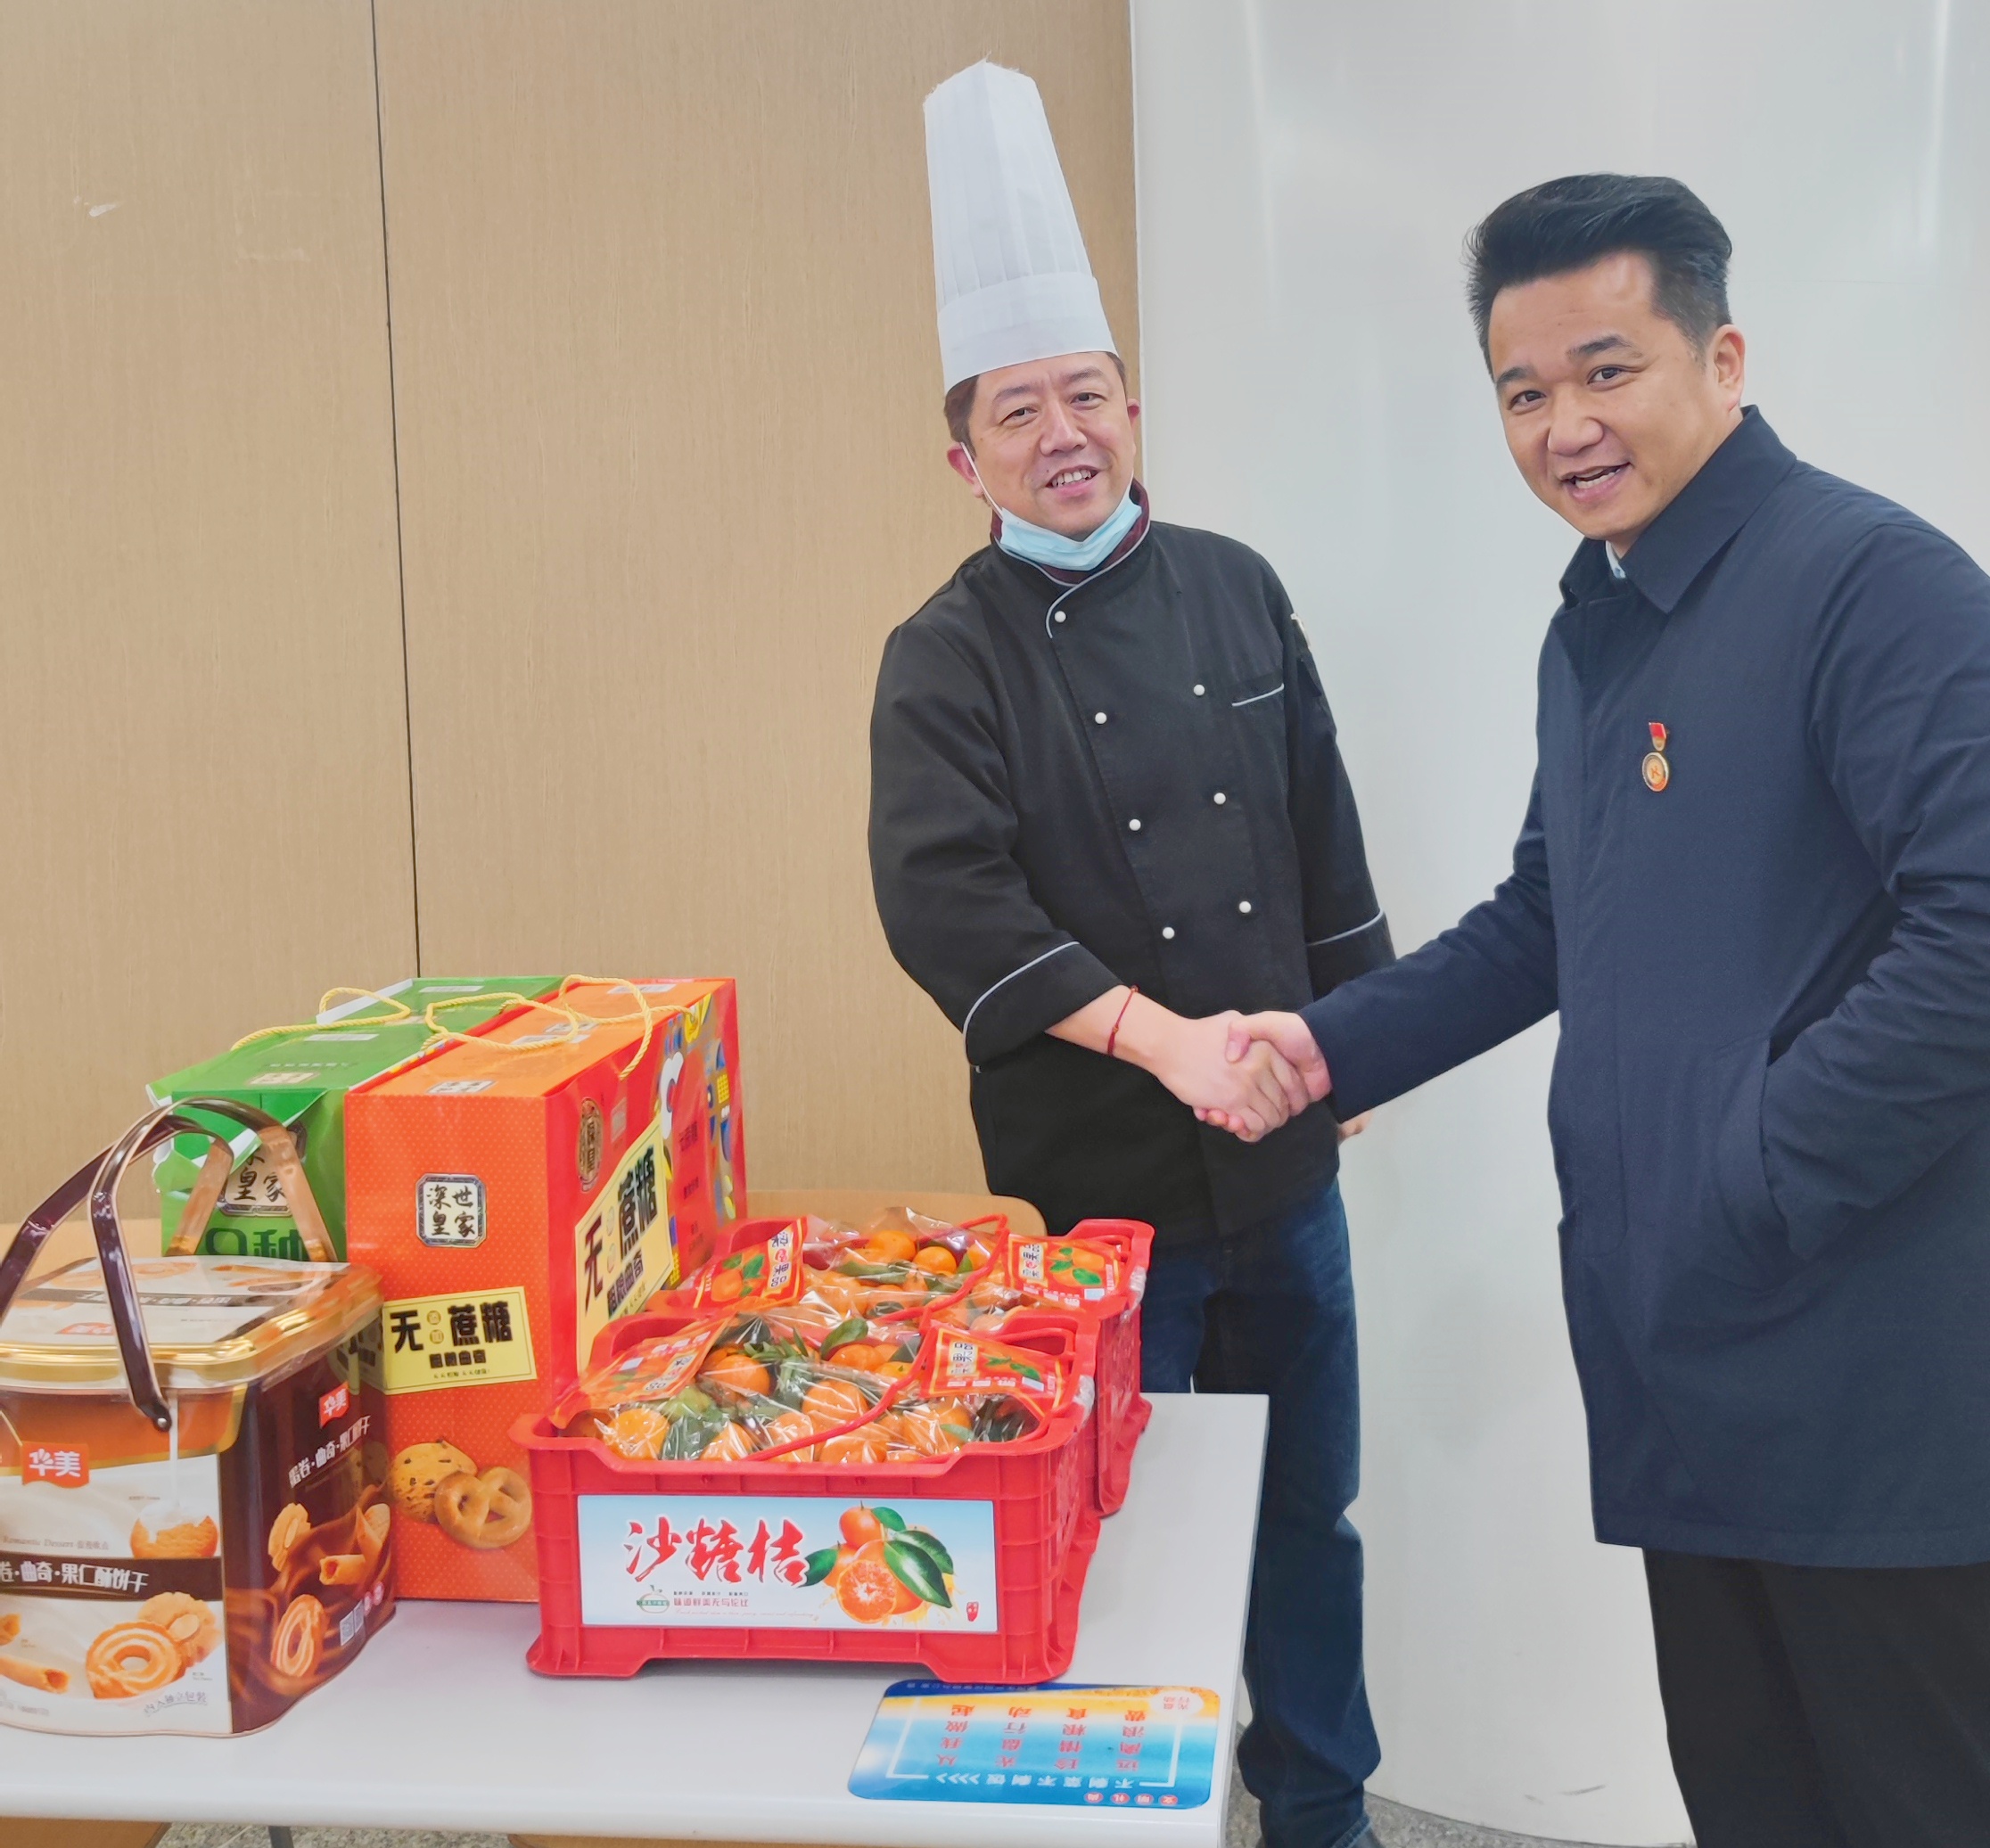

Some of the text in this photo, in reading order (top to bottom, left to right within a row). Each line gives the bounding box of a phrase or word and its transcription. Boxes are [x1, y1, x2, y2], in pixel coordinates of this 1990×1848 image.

[324, 1388, 346, 1417] 华美
[29, 1448, 81, 1477] 华美
[625, 1516, 809, 1584] 沙糖桔
[995, 1706, 1032, 1768] 光盘行动
[1055, 1708, 1087, 1770] 珍惜粮食
[1117, 1710, 1147, 1770] 远离浪费
